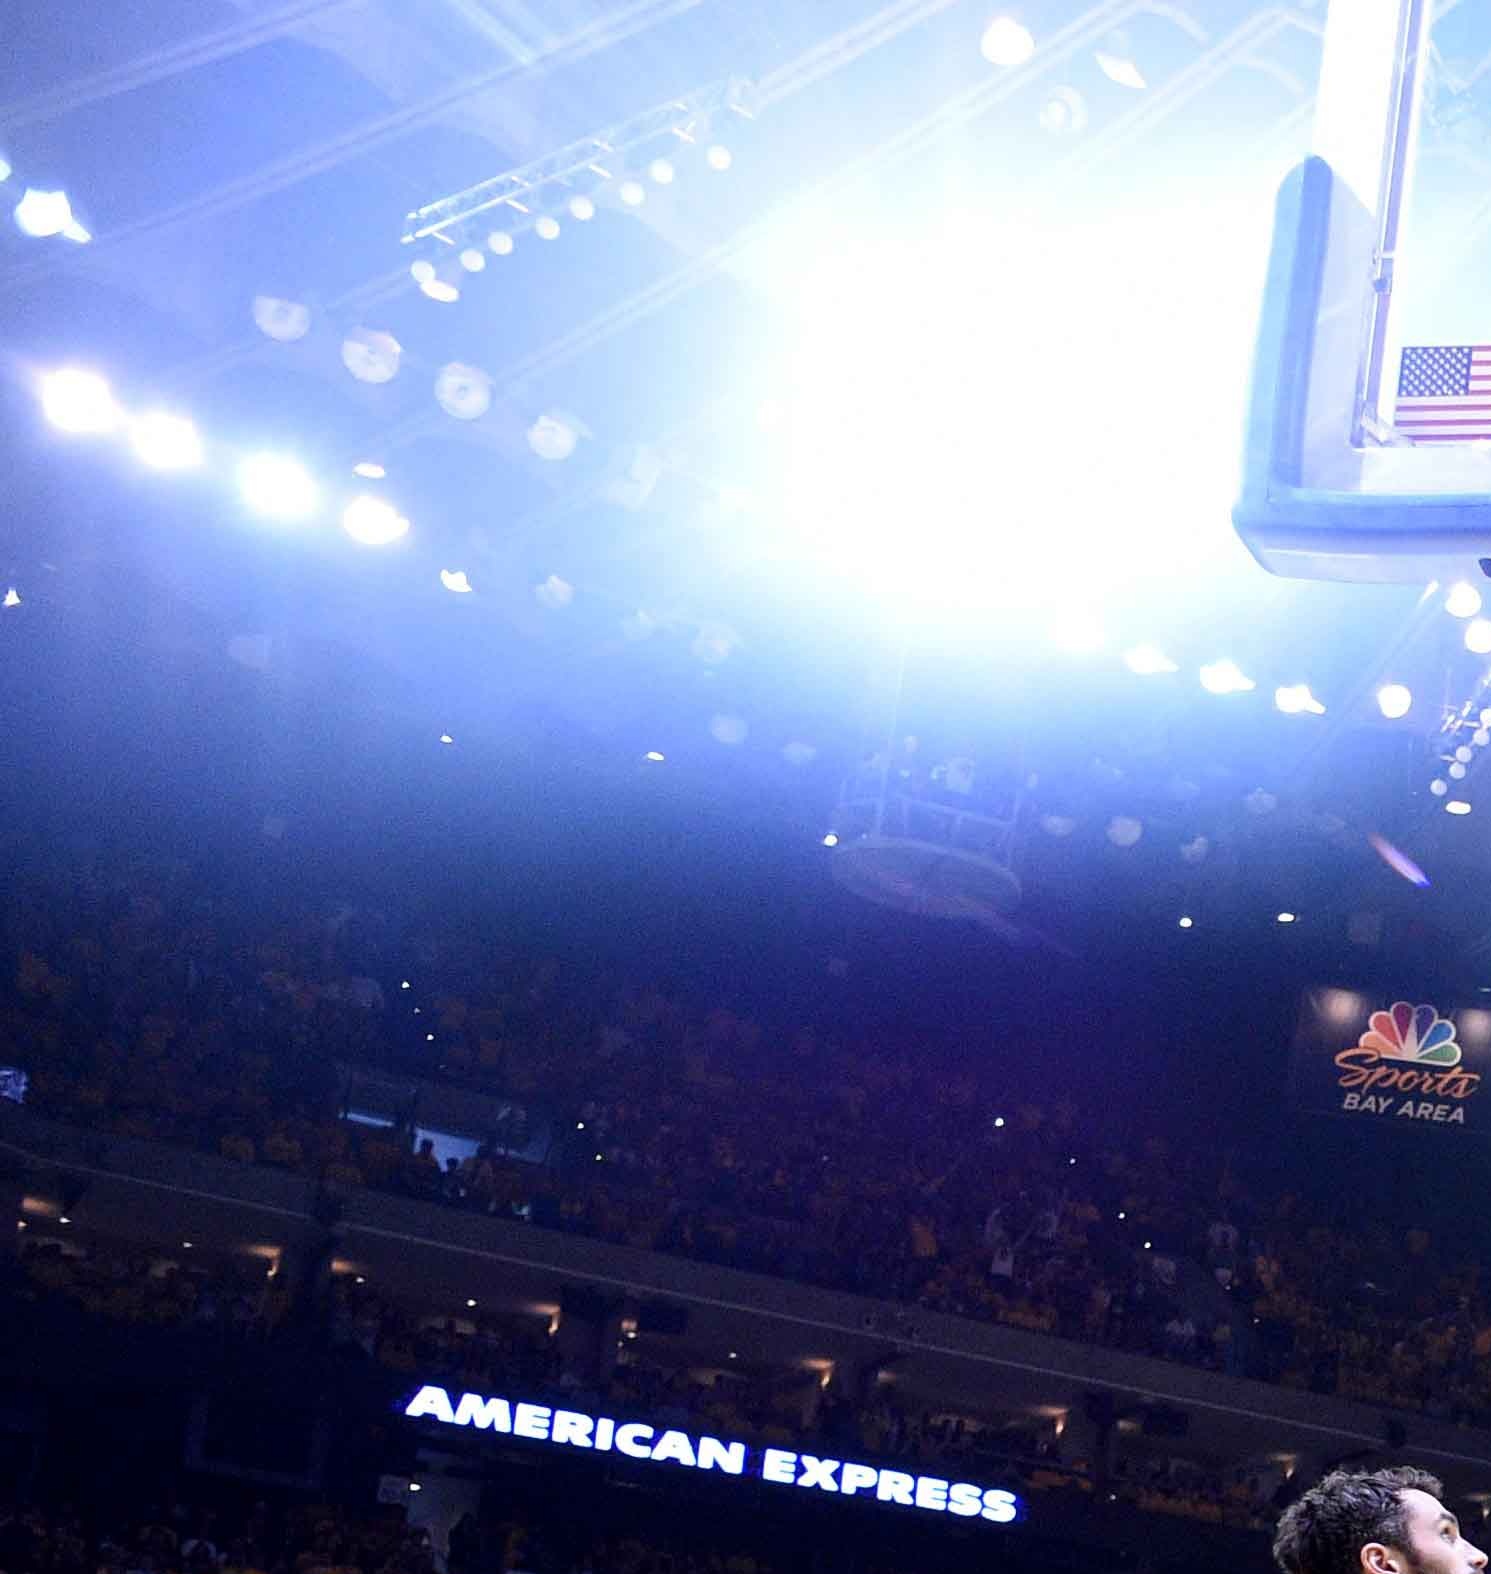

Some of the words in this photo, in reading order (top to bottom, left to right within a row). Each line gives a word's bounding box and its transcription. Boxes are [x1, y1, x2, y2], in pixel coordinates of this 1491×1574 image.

[1334, 1047, 1481, 1100] Sports
[1342, 1092, 1394, 1115] BAY
[1395, 1099, 1466, 1125] AREA
[405, 1384, 747, 1475] AMERICAN
[762, 1448, 1018, 1524] EXPRESS
